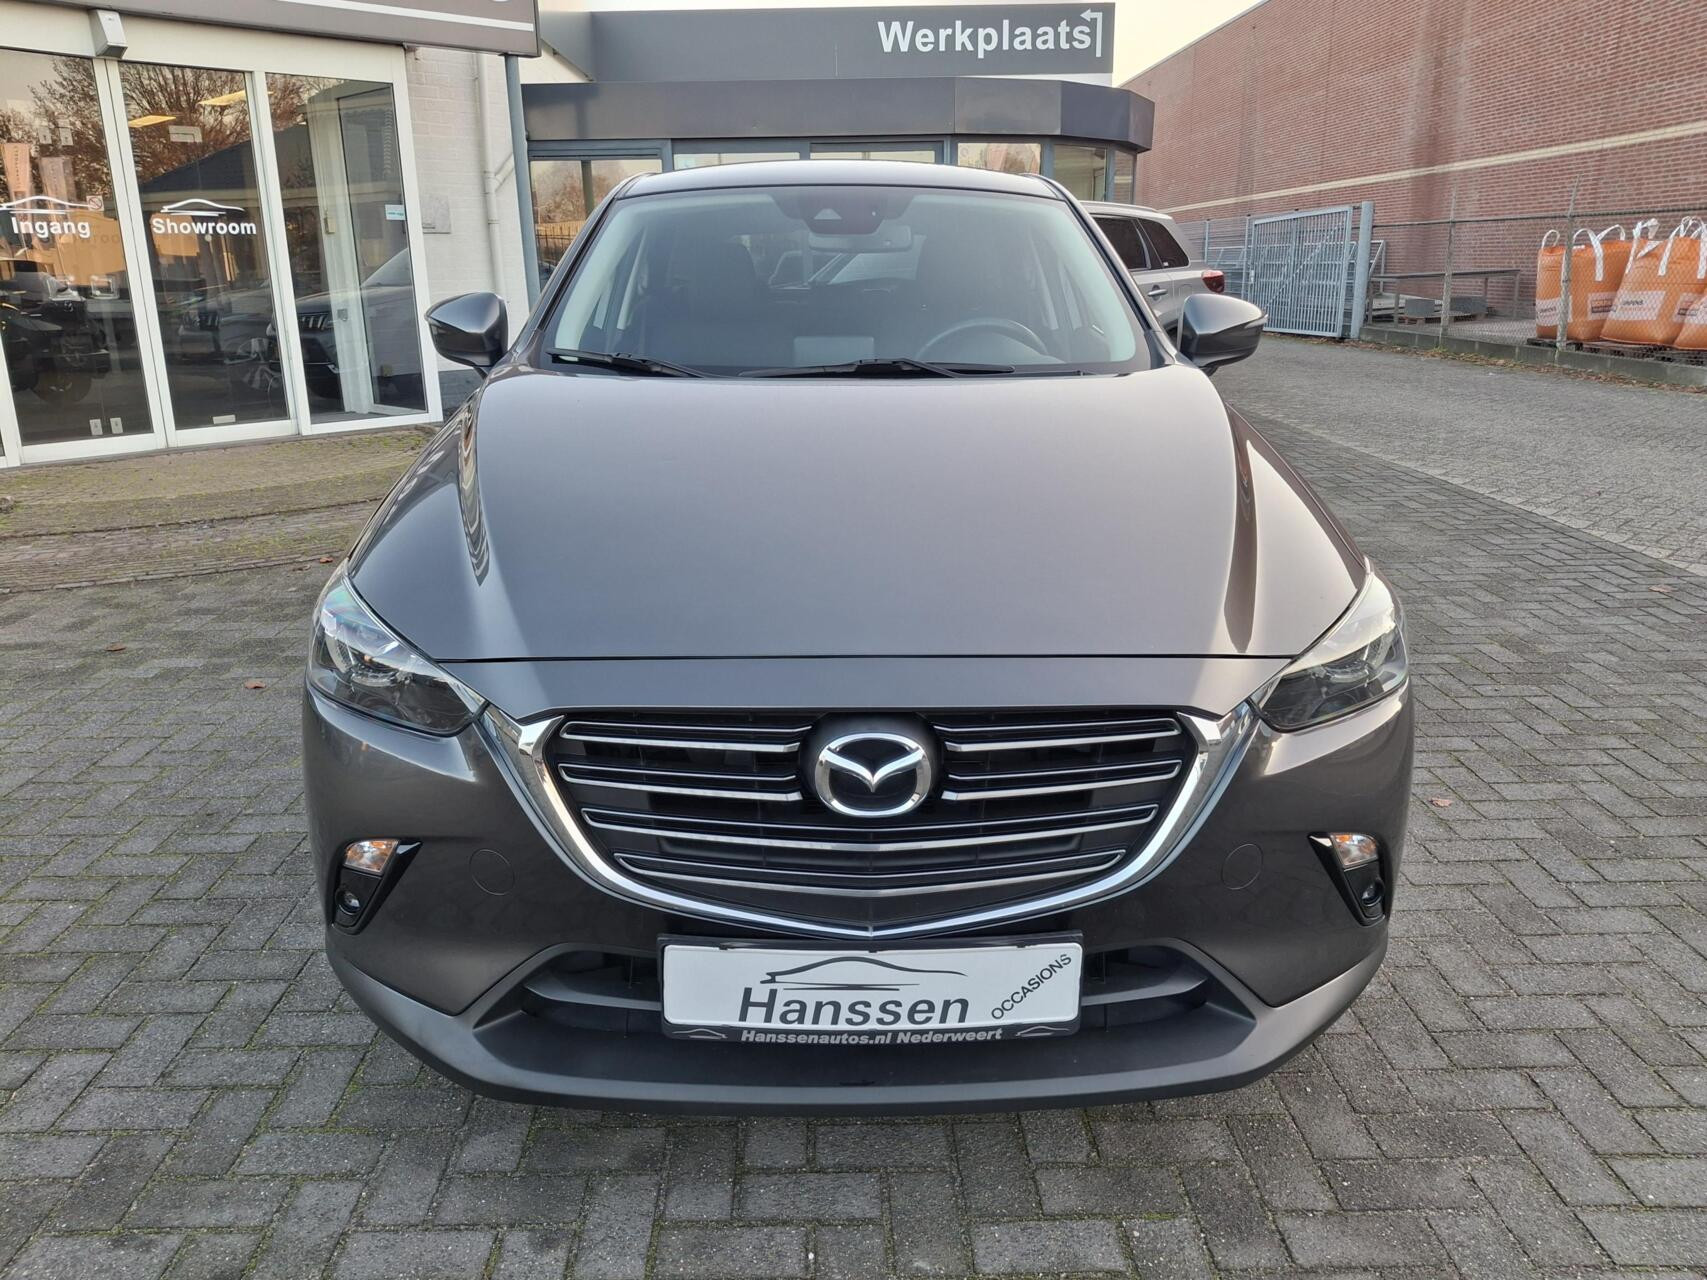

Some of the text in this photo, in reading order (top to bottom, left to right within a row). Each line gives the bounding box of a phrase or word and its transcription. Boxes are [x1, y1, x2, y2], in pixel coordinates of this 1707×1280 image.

[877, 19, 1091, 59] Werkplaats
[11, 217, 90, 239] Ingang
[151, 217, 257, 236] Showroom
[991, 953, 1072, 1021] OCCASIONS
[738, 987, 970, 1026] Hanssen
[741, 1028, 1003, 1045] Hanssenautos.nl Nederweert
